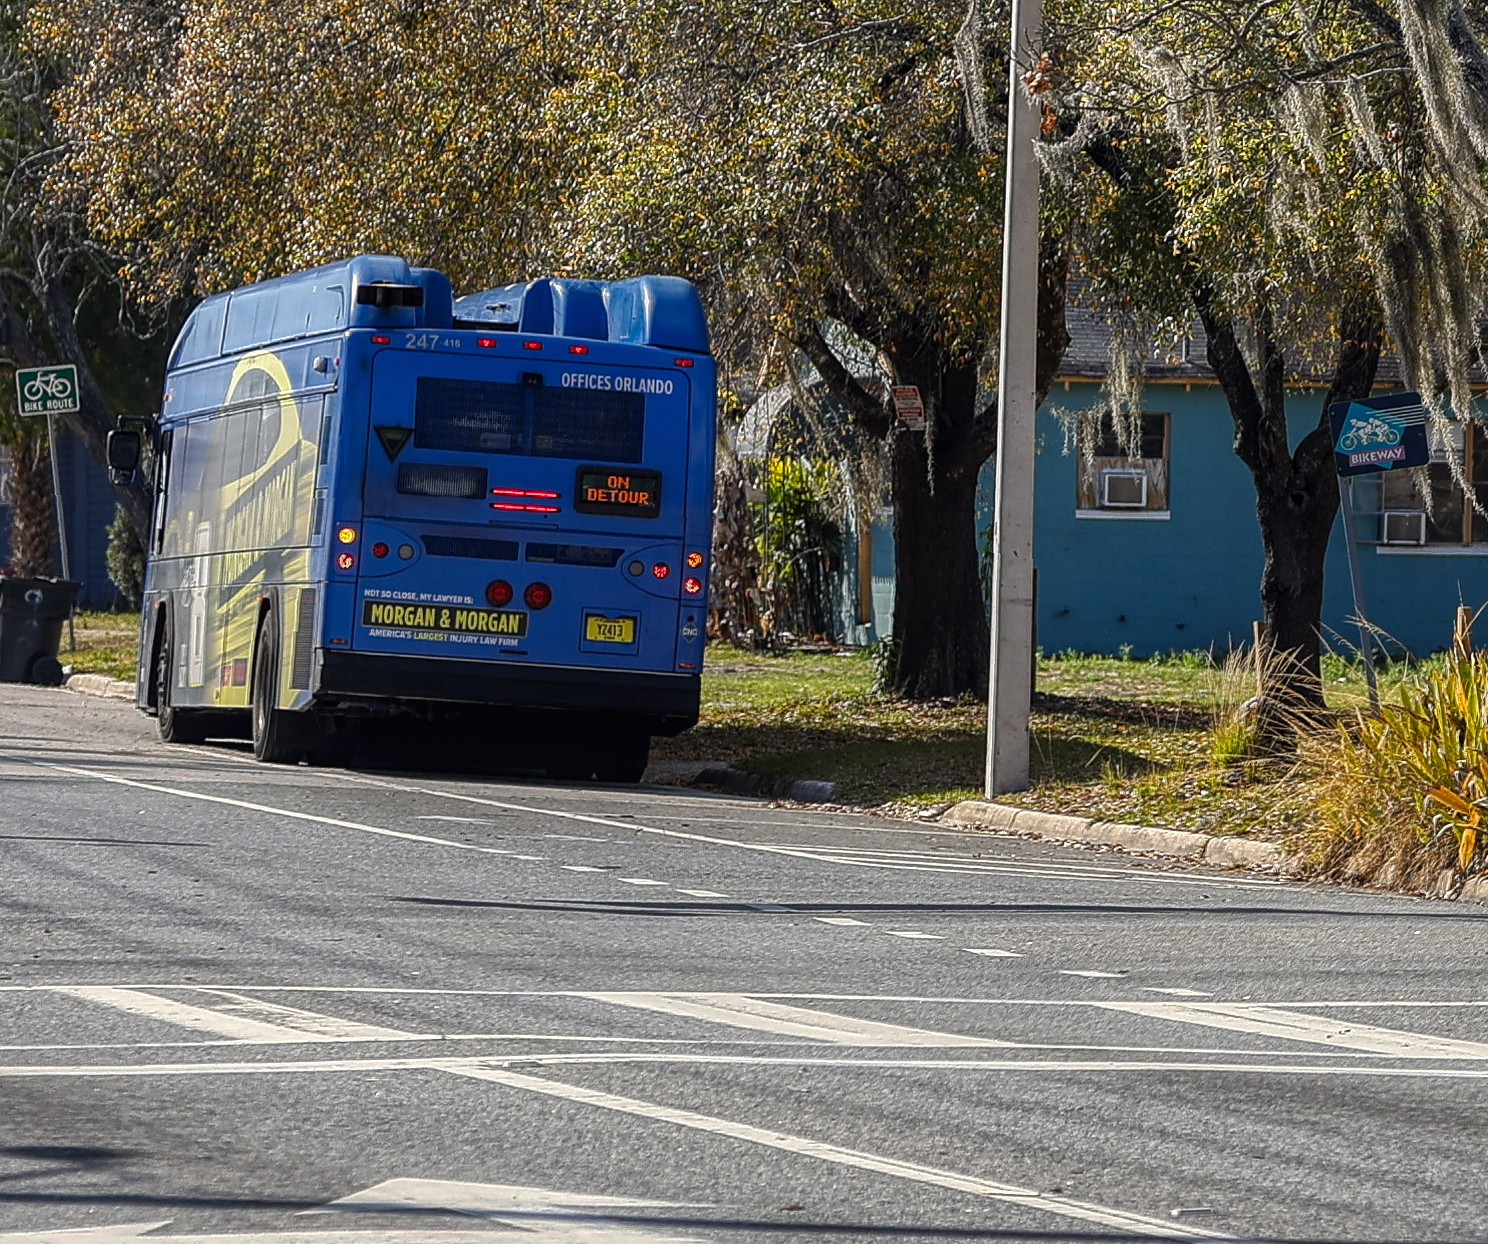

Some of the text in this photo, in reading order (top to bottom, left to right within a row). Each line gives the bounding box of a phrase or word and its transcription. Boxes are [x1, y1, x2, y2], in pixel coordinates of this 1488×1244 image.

[562, 372, 673, 395] OFFICES ORLANDO
[24, 398, 74, 412] BIKE ROUTE
[1351, 448, 1403, 464] BIKEWAY
[607, 475, 630, 489] ON
[587, 488, 649, 504] DETOUR
[364, 589, 381, 597] NOT
[381, 590, 391, 598] SO
[420, 593, 432, 601] MY
[432, 594, 463, 604] LAWYER
[371, 603, 520, 633] MORGAN & MORGAN
[368, 628, 518, 647] AMERICA'S LARGEST INJURY LAW FIRM
[682, 627, 698, 636] CNG
